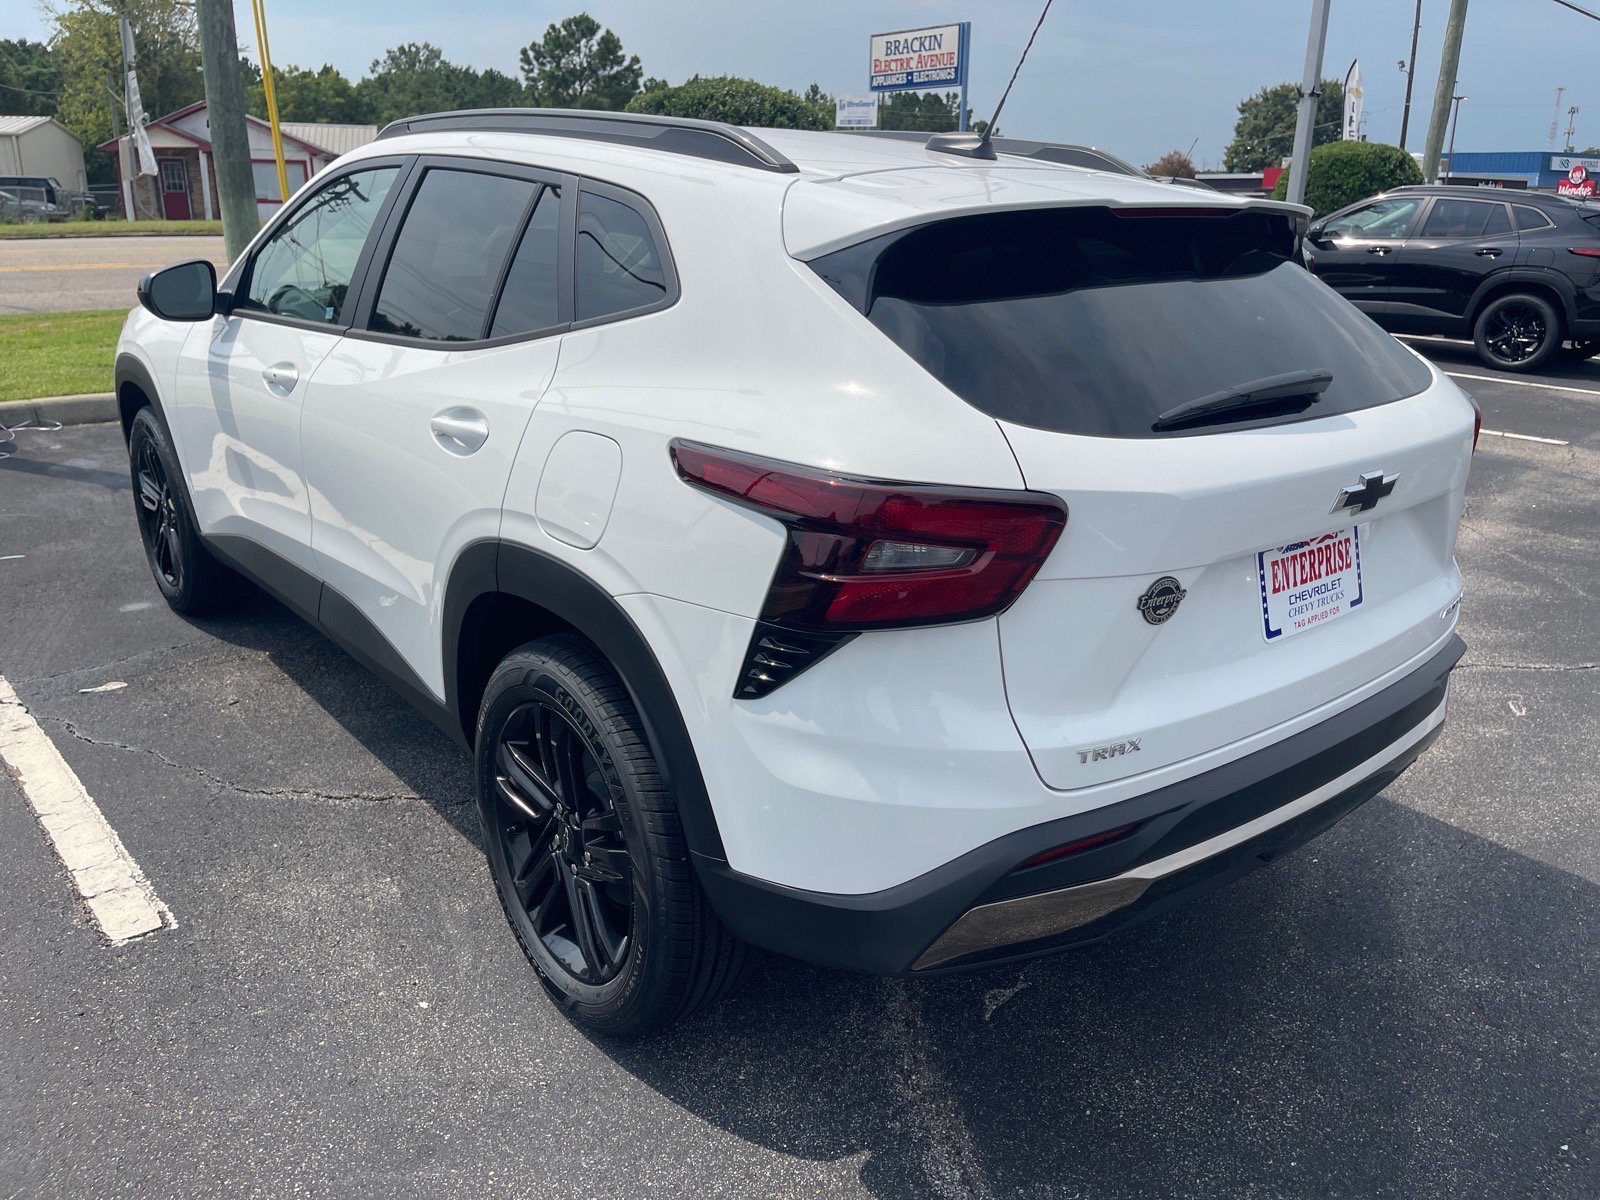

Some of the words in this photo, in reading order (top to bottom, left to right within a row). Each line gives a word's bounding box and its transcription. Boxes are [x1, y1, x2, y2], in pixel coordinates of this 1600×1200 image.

[885, 34, 943, 57] BRACKIN
[873, 57, 914, 74] ELECTRIC
[916, 52, 955, 69] AVENUE
[872, 73, 907, 87] APPLIANCES
[913, 68, 955, 83] ELECTRONICS
[1558, 183, 1592, 197] Wendy's
[1271, 537, 1352, 595] ENTERPRISE
[1139, 589, 1187, 610] Enterprise
[1288, 578, 1342, 605] CHEVROLET
[1288, 601, 1316, 618] CHEVY
[1316, 590, 1344, 608] TRUCKS
[1294, 618, 1306, 629] TAG
[1307, 610, 1329, 625] APPLIED
[1330, 606, 1340, 616] FOR
[1077, 737, 1141, 763] TRAX
